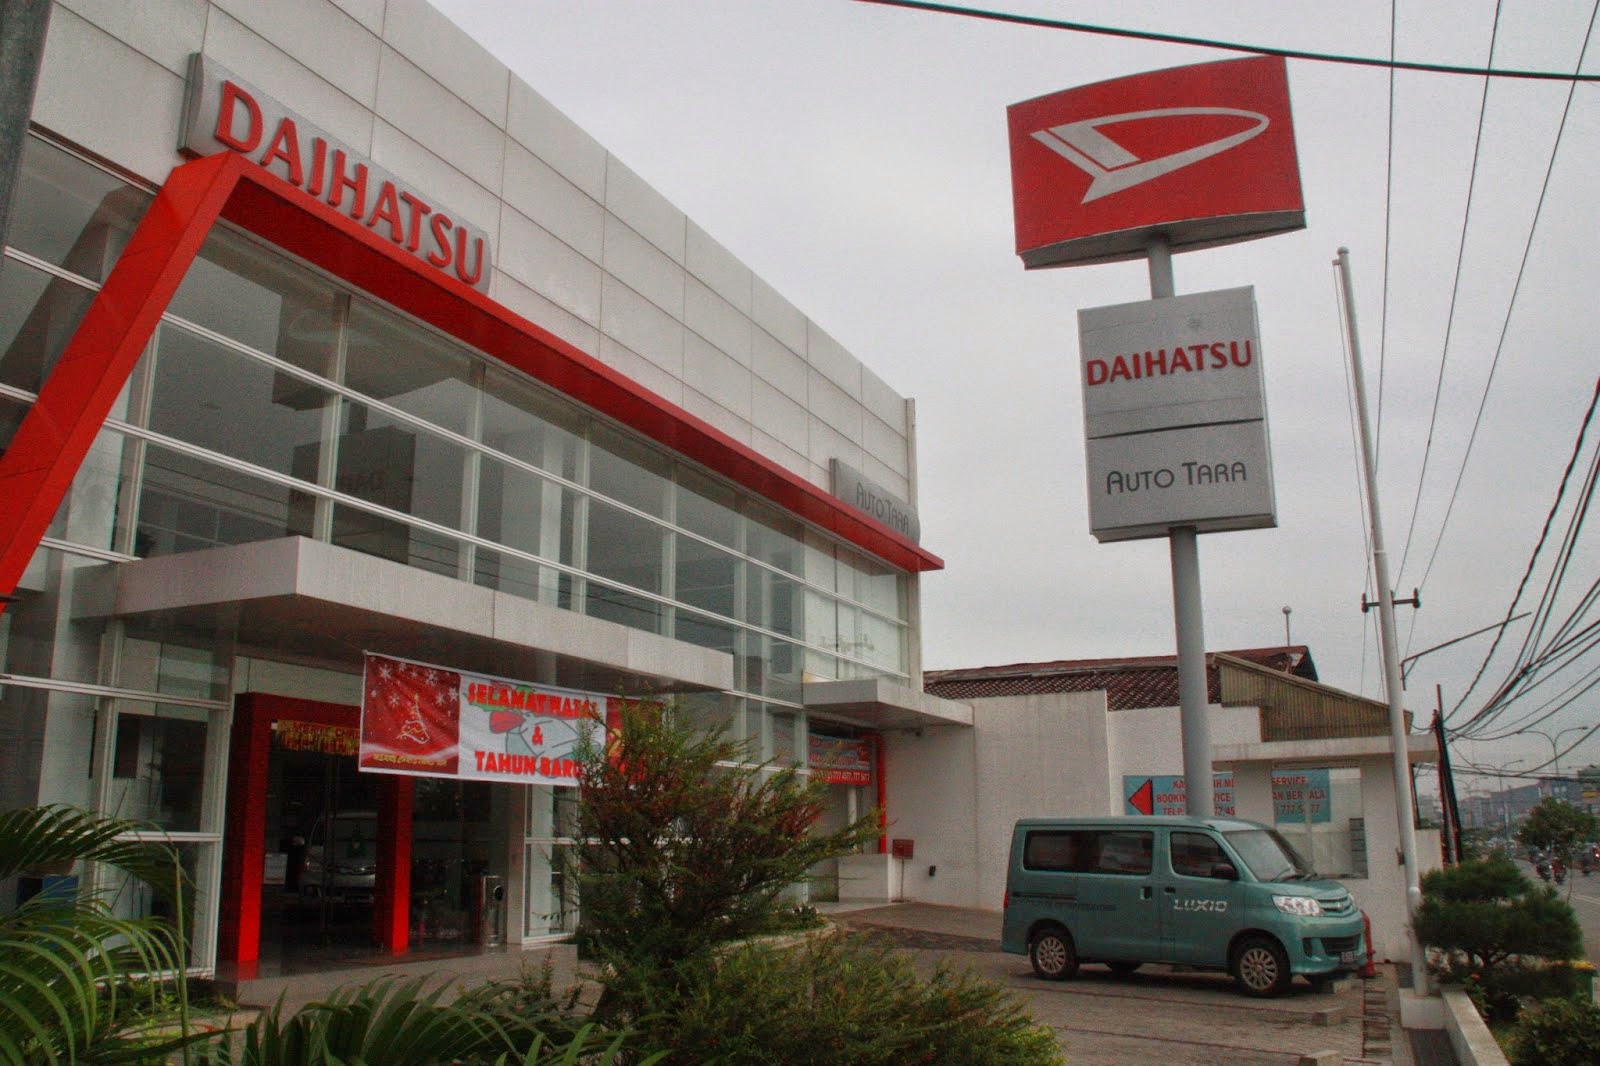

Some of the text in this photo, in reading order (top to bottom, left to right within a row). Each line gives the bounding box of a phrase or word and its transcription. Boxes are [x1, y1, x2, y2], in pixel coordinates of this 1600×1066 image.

[214, 79, 484, 285] DAIHATSU
[1086, 340, 1252, 386] DAIHATSU
[1107, 461, 1247, 495] AUTO TARA
[467, 682, 548, 713] SELAMAT
[531, 725, 544, 746] &
[474, 750, 536, 776] TAHUN
[1156, 793, 1187, 803] BOOKIN
[1286, 789, 1326, 801] BERALA
